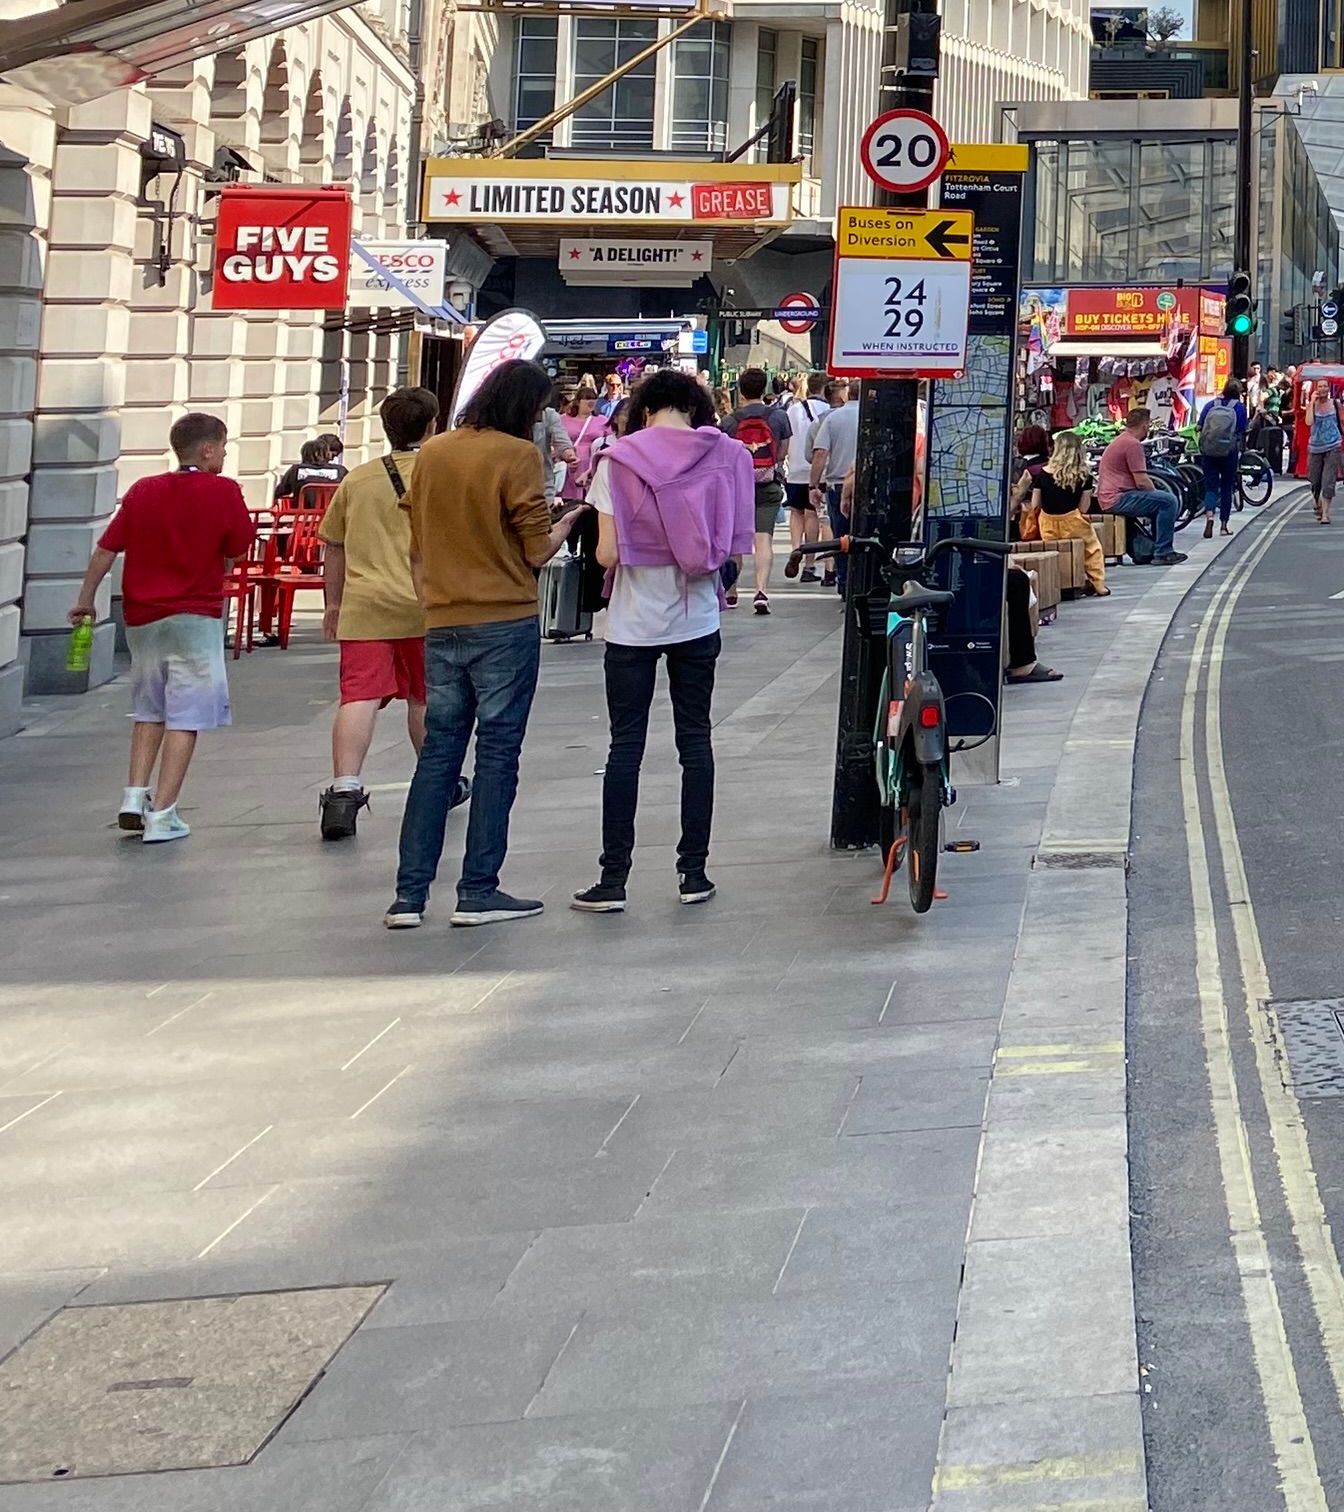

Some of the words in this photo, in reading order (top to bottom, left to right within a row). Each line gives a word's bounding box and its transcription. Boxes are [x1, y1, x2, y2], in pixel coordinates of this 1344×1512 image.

[876, 134, 937, 168] 20
[945, 175, 990, 183] FITZROVIA
[945, 183, 991, 192] Tottenham
[993, 184, 1018, 192] Court
[470, 184, 565, 215] LIMITED
[570, 184, 661, 215] SEASON
[699, 188, 768, 212] GREASE
[944, 192, 966, 200] Road
[849, 216, 891, 230] Buses
[895, 220, 914, 230] on
[236, 226, 329, 253] FIVE
[848, 233, 916, 248] Diversion
[607, 246, 684, 263] DELIGHT!"
[222, 254, 339, 283] GUYS
[884, 276, 927, 306] 24
[1116, 292, 1132, 302] BIG
[774, 309, 820, 318] UNDERGROUND
[1075, 314, 1100, 325] BUY
[1102, 313, 1154, 324] TICKETS
[1157, 312, 1190, 324] HE
[883, 308, 924, 338] 29
[862, 342, 894, 352] WHEN
[896, 342, 958, 352] INSTRUCTED
